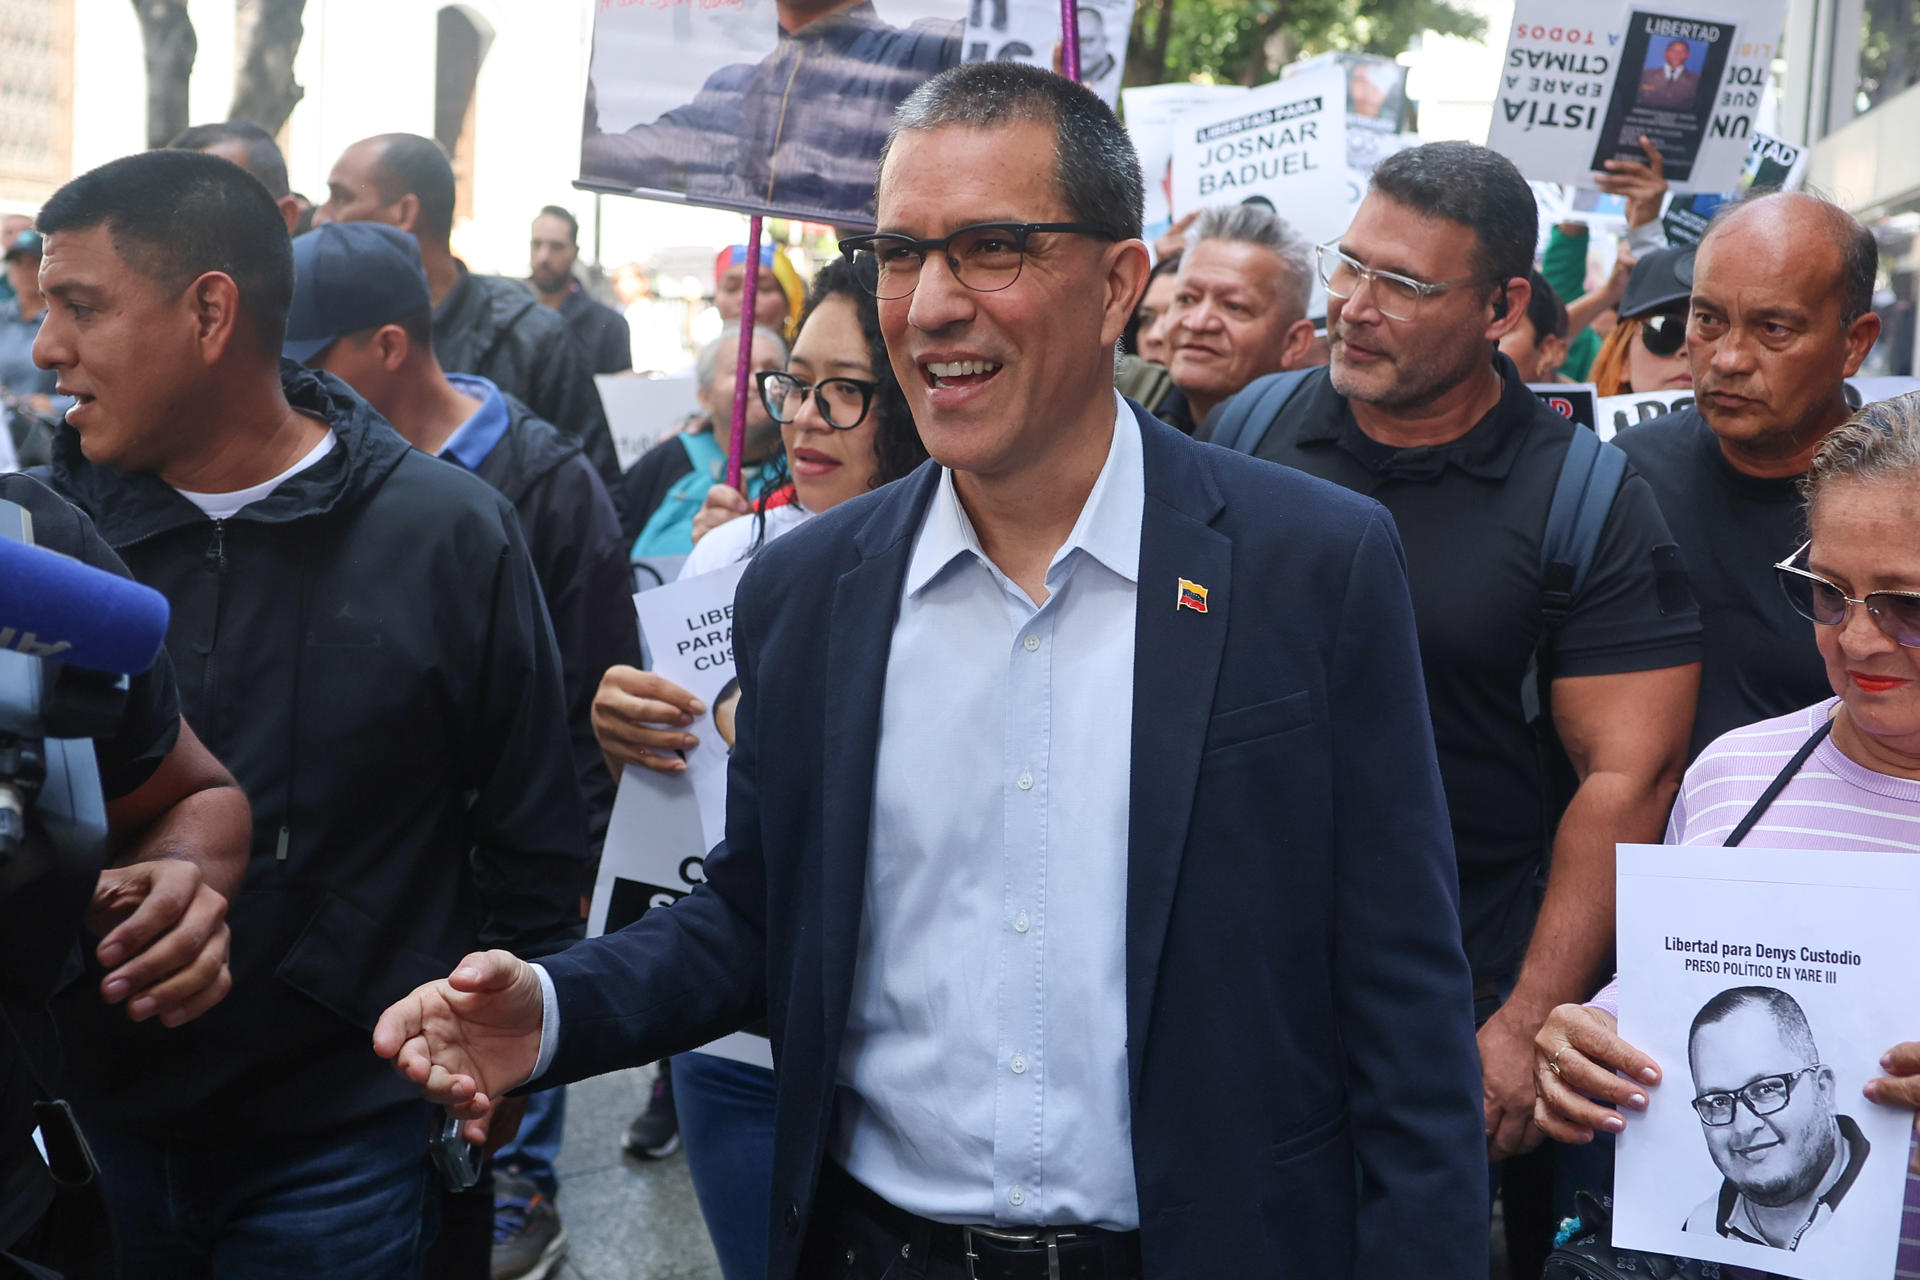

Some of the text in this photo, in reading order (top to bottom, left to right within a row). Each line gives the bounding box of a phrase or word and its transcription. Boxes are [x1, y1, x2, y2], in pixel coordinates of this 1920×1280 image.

[1516, 24, 1595, 45] TODOS
[1644, 16, 1721, 43] LIBERTAD
[1510, 48, 1609, 75] CTIMAS
[1506, 74, 1758, 107] QUE EPARE A
[1503, 98, 1597, 132] ISTÍA
[1711, 114, 1750, 138] UN
[1199, 121, 1317, 168] JOSNAR
[1199, 150, 1318, 196] BADUEL
[1664, 936, 1861, 966] Libertad para Denys Custodio
[1685, 958, 1837, 984] PRESO POLÍTICO EN YARE III
